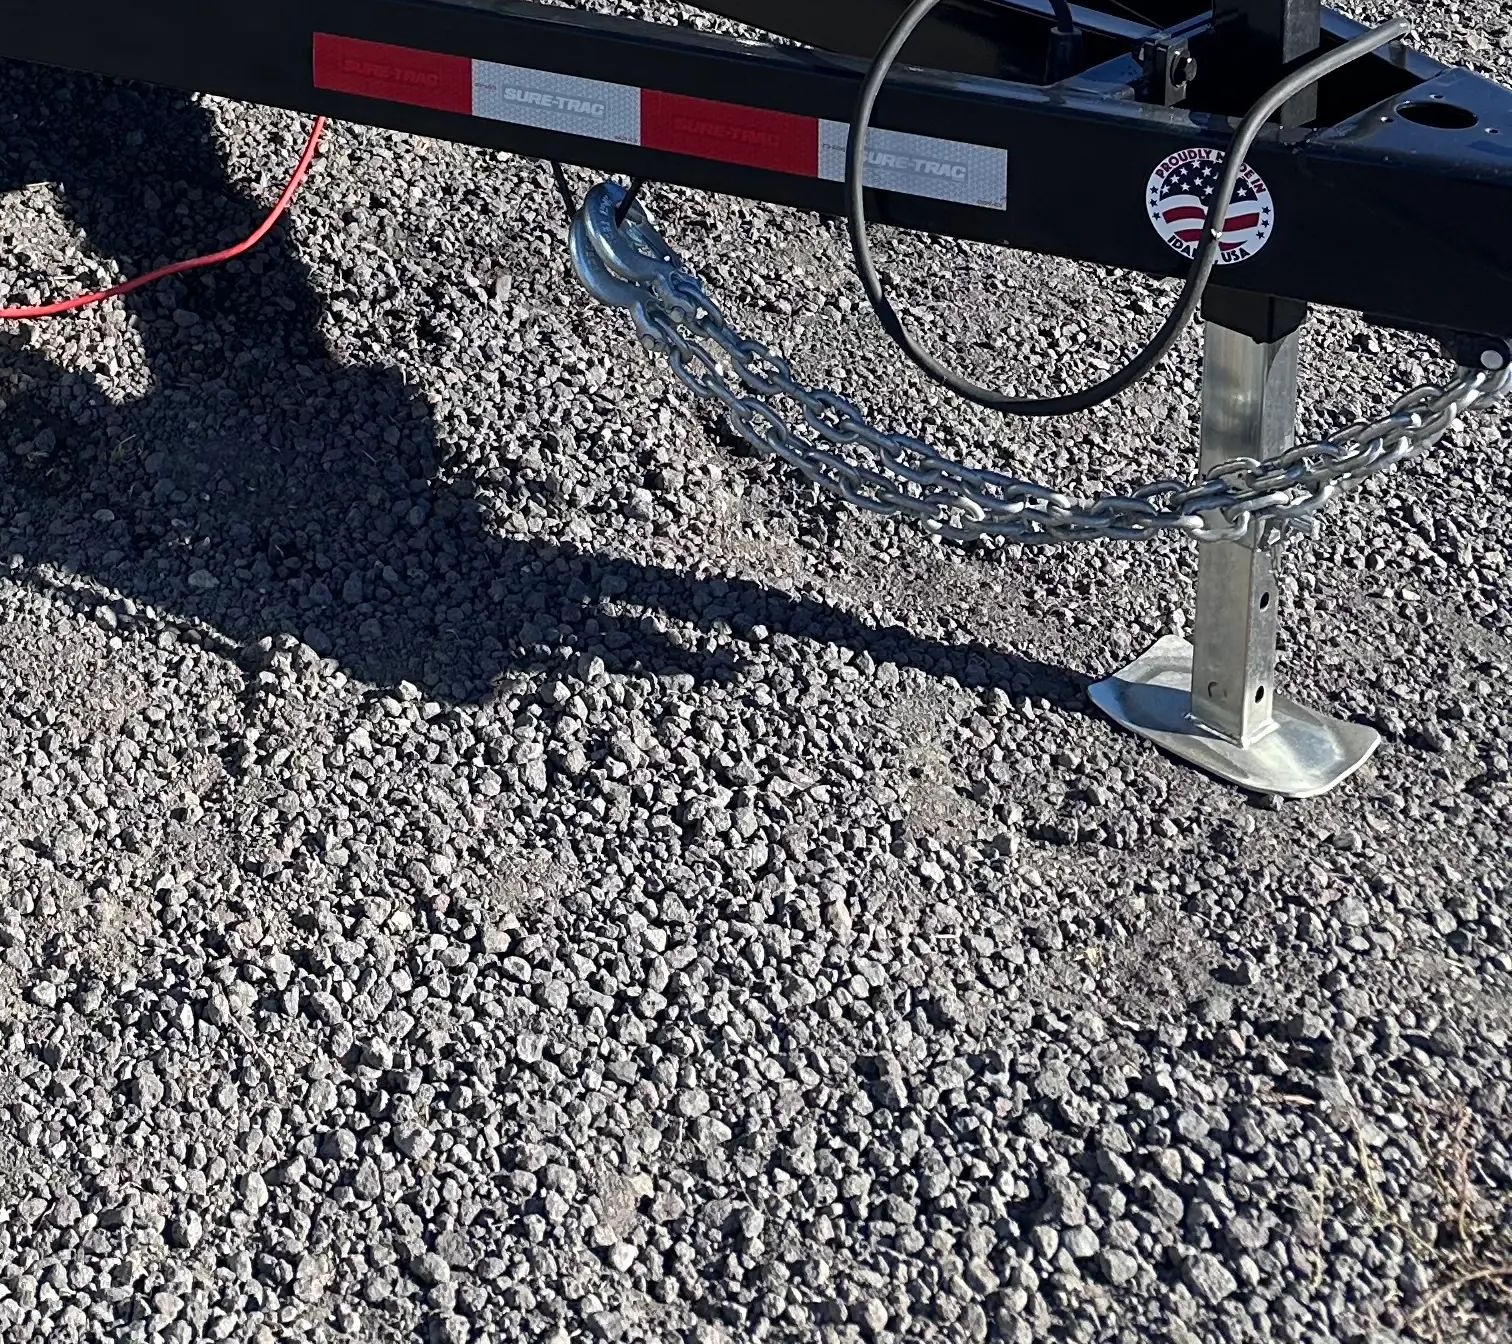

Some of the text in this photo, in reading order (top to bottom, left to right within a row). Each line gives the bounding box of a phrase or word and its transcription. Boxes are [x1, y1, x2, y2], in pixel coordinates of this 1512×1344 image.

[344, 60, 438, 86] SURE-TRAC
[503, 87, 604, 116] SURE-TRAC
[864, 151, 967, 179] URE-TRAC
[1155, 148, 1212, 179] PROUDLY
[1250, 177, 1266, 194] IN
[1221, 247, 1251, 263] USA
